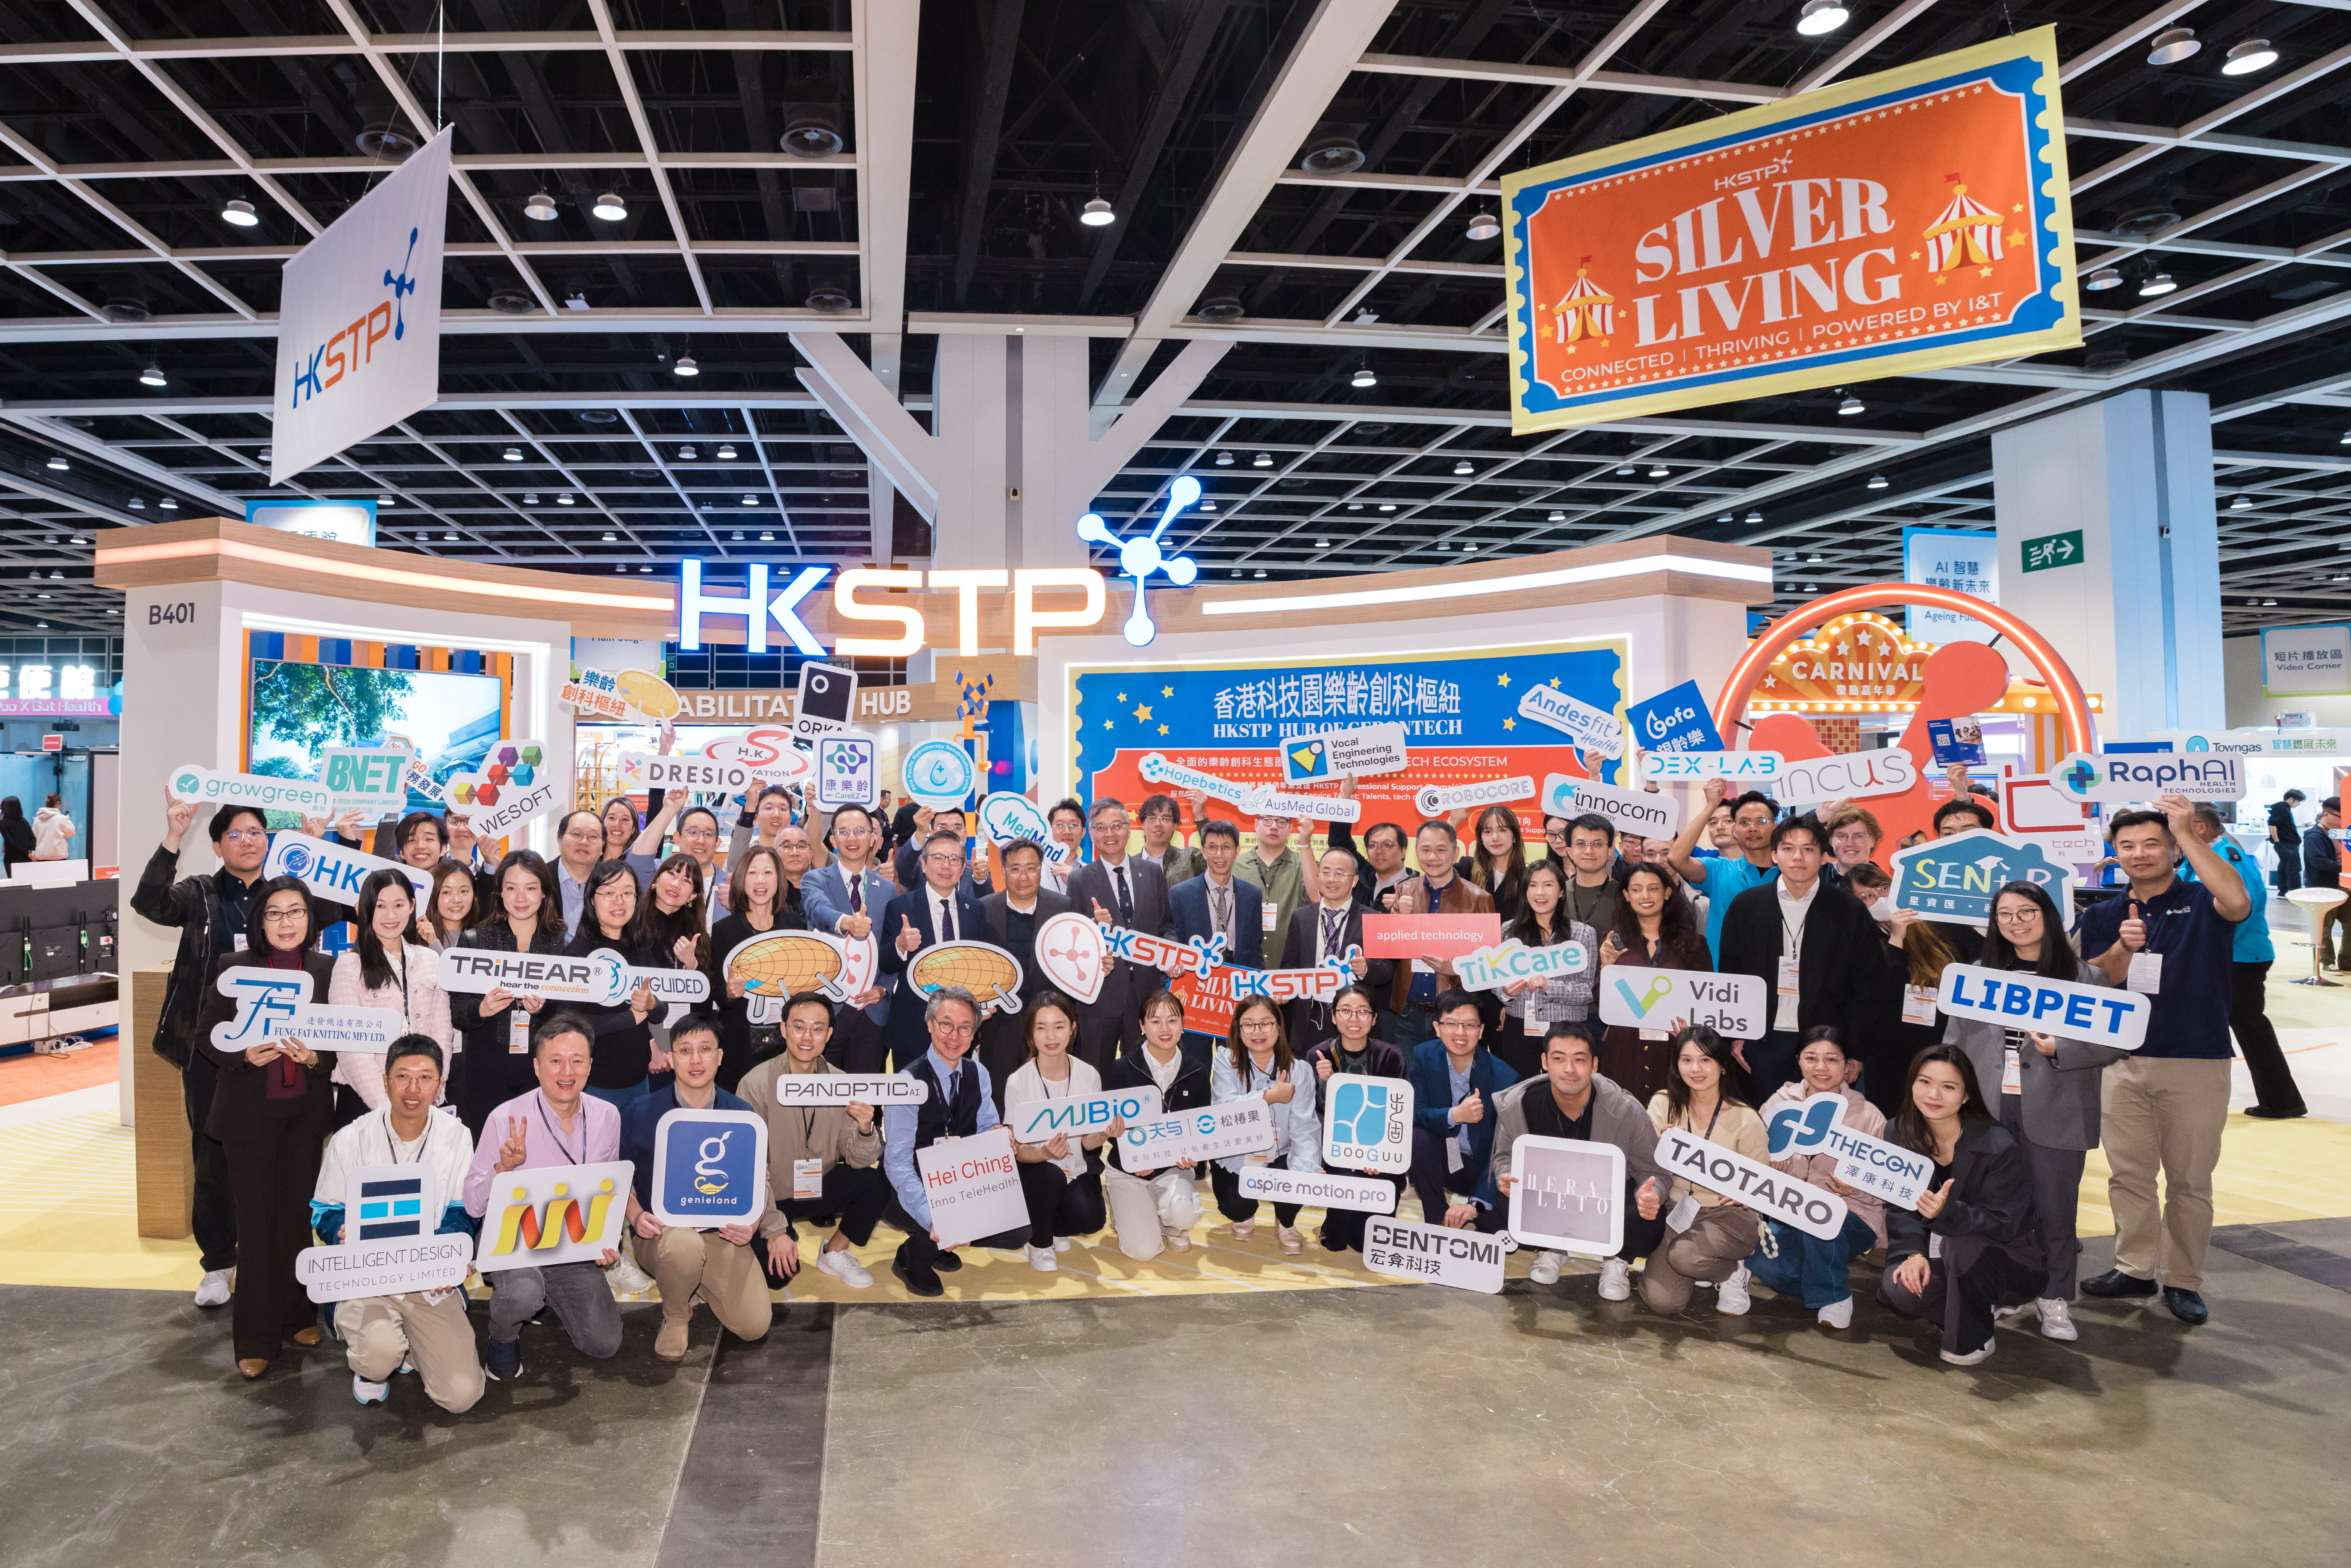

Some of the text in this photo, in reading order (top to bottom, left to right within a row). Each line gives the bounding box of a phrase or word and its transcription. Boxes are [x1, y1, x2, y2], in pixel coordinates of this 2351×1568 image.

[1715, 164, 1779, 191] HKSTP
[1635, 177, 1895, 284] SILVER
[1632, 247, 1902, 347] LIVING
[1561, 292, 2003, 383] CONNECTED THRIVING POWERED BY I&T
[293, 301, 391, 409] HKSTP
[1935, 561, 1979, 575] AI 智慧
[149, 602, 194, 625] B401
[680, 558, 1106, 658] HKSTP
[1925, 611, 1956, 623] Ageing
[2274, 649, 2342, 661] 短片播放區
[583, 670, 616, 693] 樂齡
[1793, 661, 1924, 682] CARNIVAL
[561, 684, 626, 717] 創科樞紐
[1214, 670, 1461, 719] 香港科技園樂齡創科樞紐
[1836, 684, 1896, 697] 樂動嘉年華
[32, 701, 56, 712] Gut
[58, 701, 101, 712] Health
[861, 691, 911, 716] HUB
[1529, 691, 1614, 737] Andesfit
[1214, 724, 1272, 737] HKSTP
[1279, 722, 1316, 736] HUB
[1656, 728, 1706, 752] 銀齡樂
[1331, 737, 1359, 749] Vocal
[1332, 744, 1392, 760] Engineering
[1581, 734, 1618, 753] Health
[2213, 743, 2261, 754] Towngas
[2272, 739, 2337, 749] 智慧燃展未來
[912, 744, 944, 759] Hydrotherapy
[946, 745, 969, 774] Rehabilitation
[962, 776, 970, 792] Center
[1334, 754, 1400, 770] Technologies
[1406, 757, 1429, 766] ECH
[1433, 756, 1507, 766] ECOSYSTEM
[1650, 756, 1776, 774] DEX-LAB
[326, 755, 406, 793] BNET
[407, 769, 442, 798] 務發展
[649, 763, 745, 787] DRESIO
[825, 779, 868, 792] 康樂齡
[2109, 759, 2235, 788] RaphAI
[206, 778, 327, 805] growgreen
[1442, 781, 1530, 805] ROBOCORE
[479, 784, 553, 834] WESOFT
[1265, 799, 1354, 817] AusMed Global
[1575, 787, 1666, 824] innocorn
[1002, 811, 1064, 862] MedMnd
[2052, 838, 2095, 849] tech
[1101, 925, 1197, 967] HKSTP
[1377, 930, 1484, 942] applied technology
[500, 980, 589, 994] hear the connection
[1196, 977, 1232, 998] SILV
[1235, 972, 1338, 996] HKSTP
[1690, 981, 1739, 1003] Vidi
[1190, 994, 1237, 1015] LIVIN
[1951, 975, 2135, 1034] LIBPET
[306, 1017, 382, 1029] 逢發織造有限公司
[1690, 1008, 1747, 1032] Labs
[274, 1027, 386, 1043] FUNG FAT KNITTING MFY LTD.
[1149, 1120, 1183, 1140] 天与
[1220, 1110, 1260, 1128] 松椿果
[1131, 1134, 1264, 1163] 爱与科技 让长者生活更美好
[1829, 1130, 1924, 1181] THECON
[928, 1155, 1013, 1188] Hei Ching
[1670, 1138, 1832, 1225] TAOTARO
[1844, 1164, 1914, 1200] 澤康科技
[930, 1176, 1019, 1209] Inno TeleHealth
[1246, 1178, 1386, 1203] aspire motion pro
[1528, 1174, 1597, 1197] HERA
[681, 1196, 737, 1206] genieland
[1538, 1191, 1608, 1215] LETO
[1373, 1224, 1500, 1265] DENTOMI
[309, 1244, 462, 1274] INTELLIGENT DESIGN
[318, 1267, 456, 1292] TECHNOLOGY LIMITED
